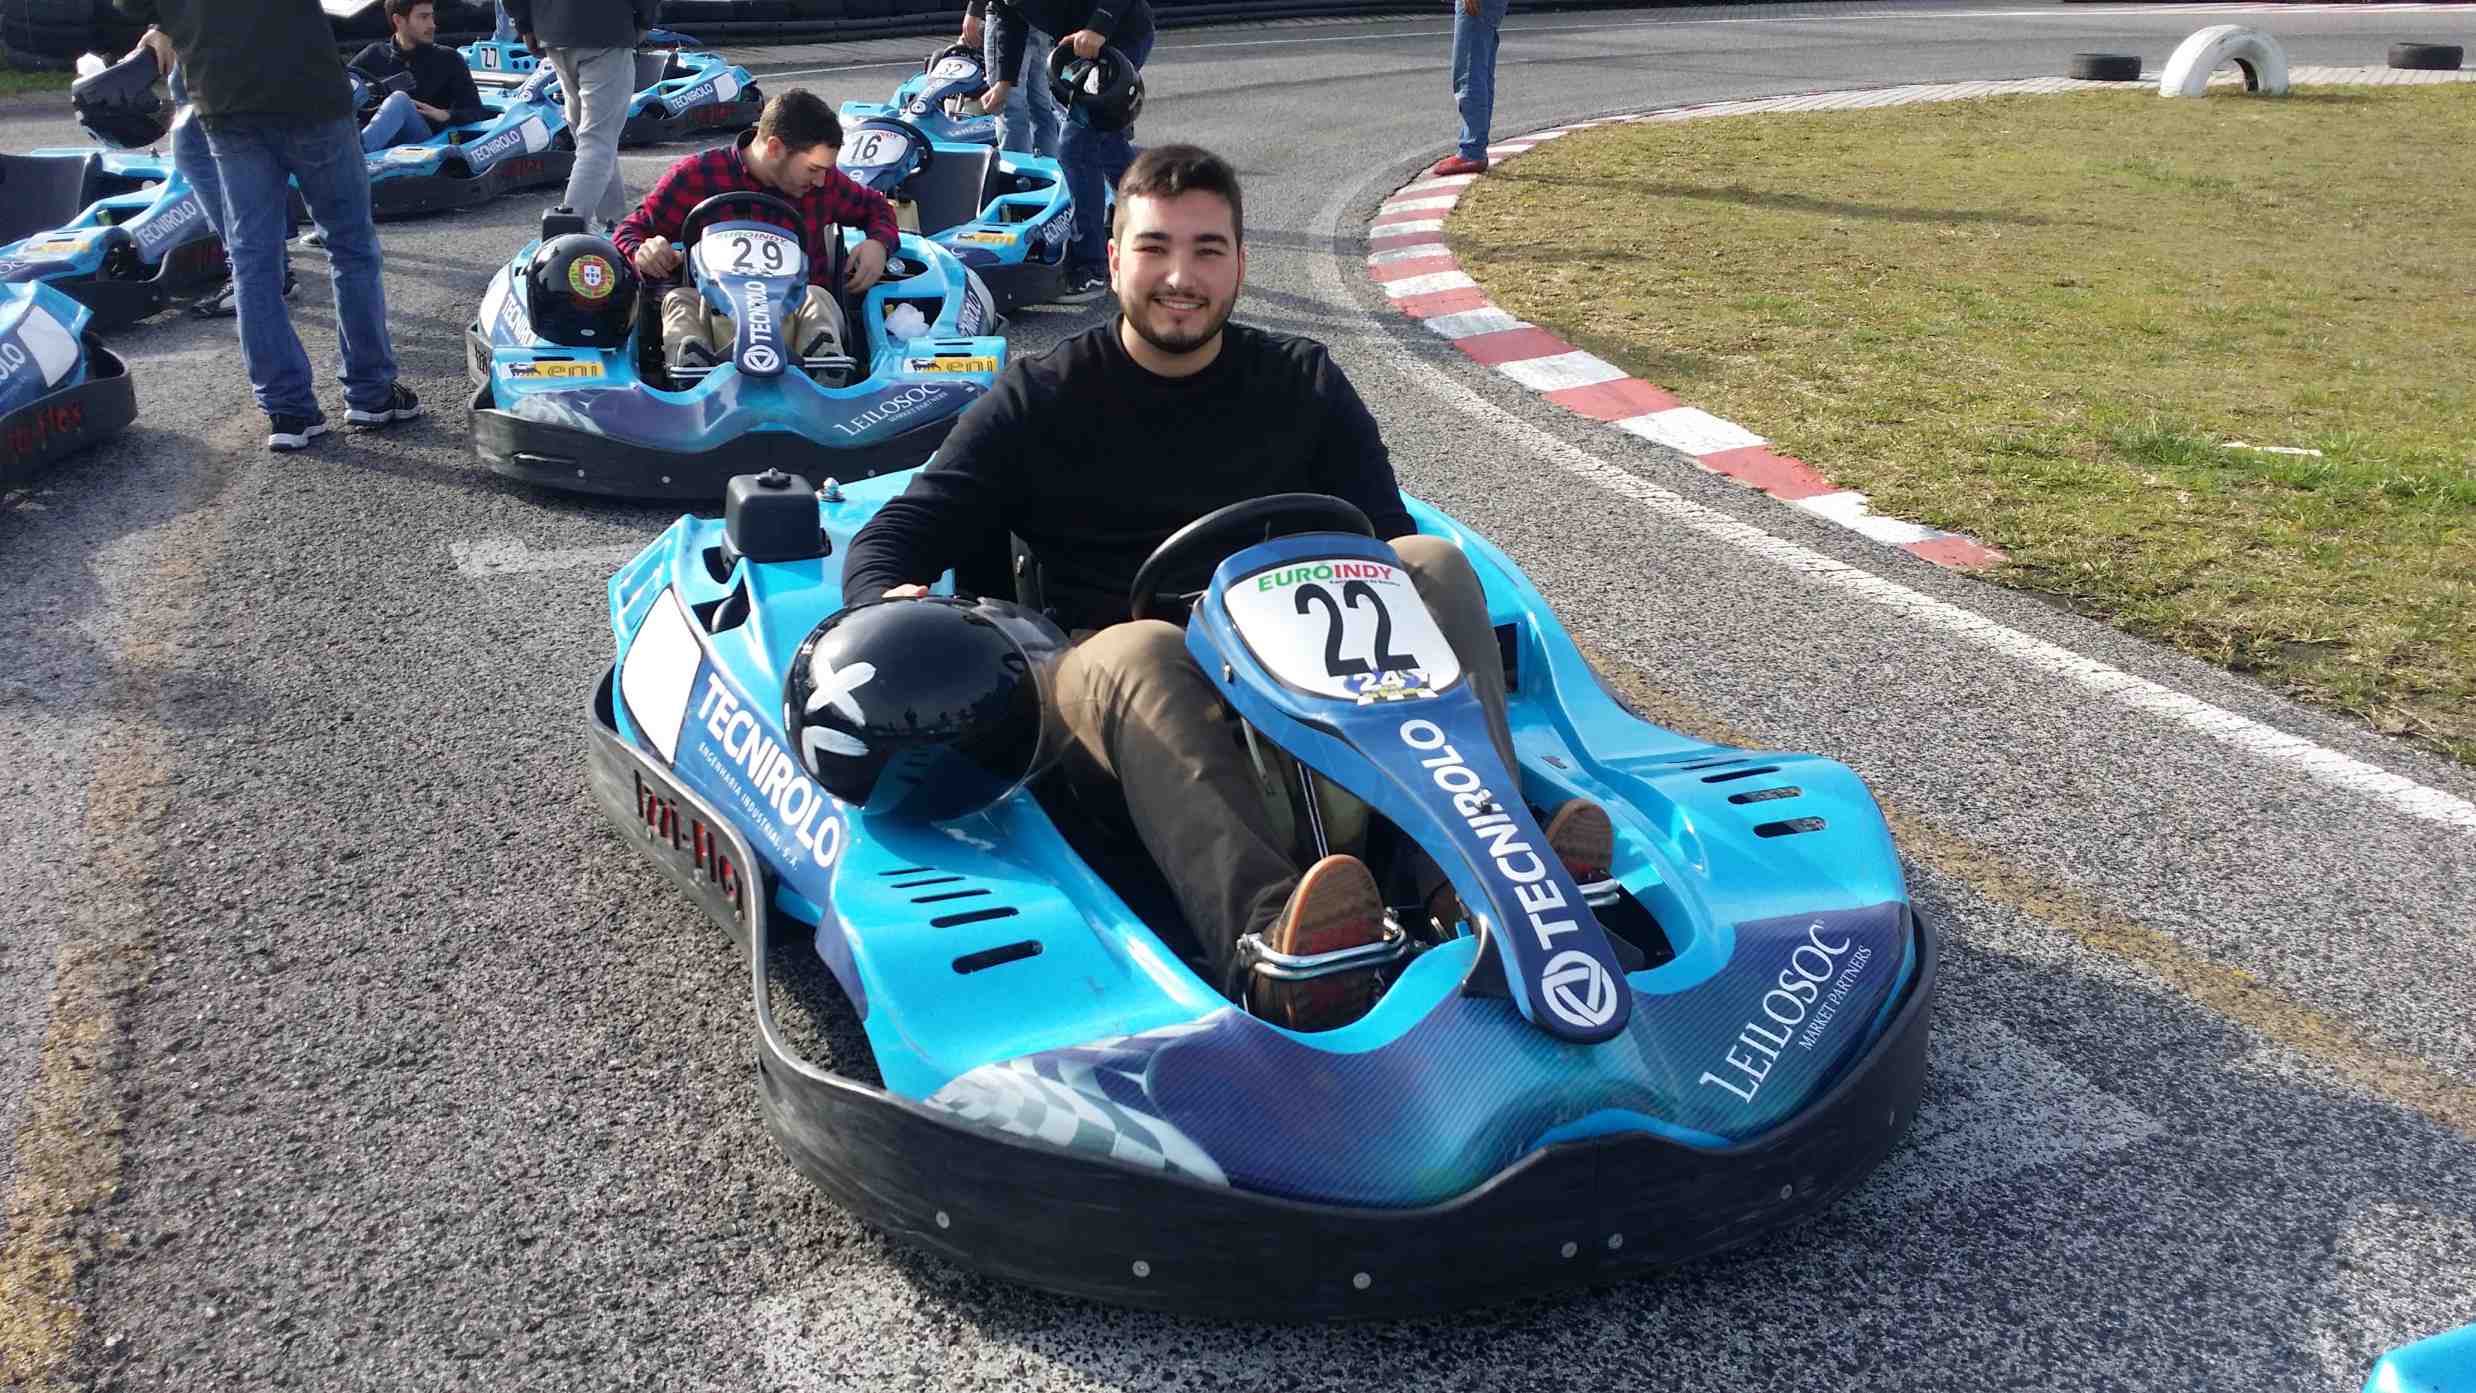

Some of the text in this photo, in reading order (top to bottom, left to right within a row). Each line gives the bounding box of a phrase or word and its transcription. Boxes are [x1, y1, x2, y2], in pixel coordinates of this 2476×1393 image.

[481, 48, 497, 68] 27
[852, 135, 882, 160] 16
[731, 237, 783, 270] 29
[547, 364, 598, 377] eni
[945, 360, 993, 373] eni
[833, 383, 941, 436] LEILOSOC
[1258, 563, 1393, 592] EUROINDY
[1294, 580, 1420, 677] 22
[698, 741, 742, 796] ENGENHARIA
[698, 672, 841, 869] TECNIROLO
[1400, 719, 1579, 950] TECNIROLO
[1699, 923, 1851, 1104] LEILOSOC
[1799, 944, 1873, 1051] MARKET PARTNERS
